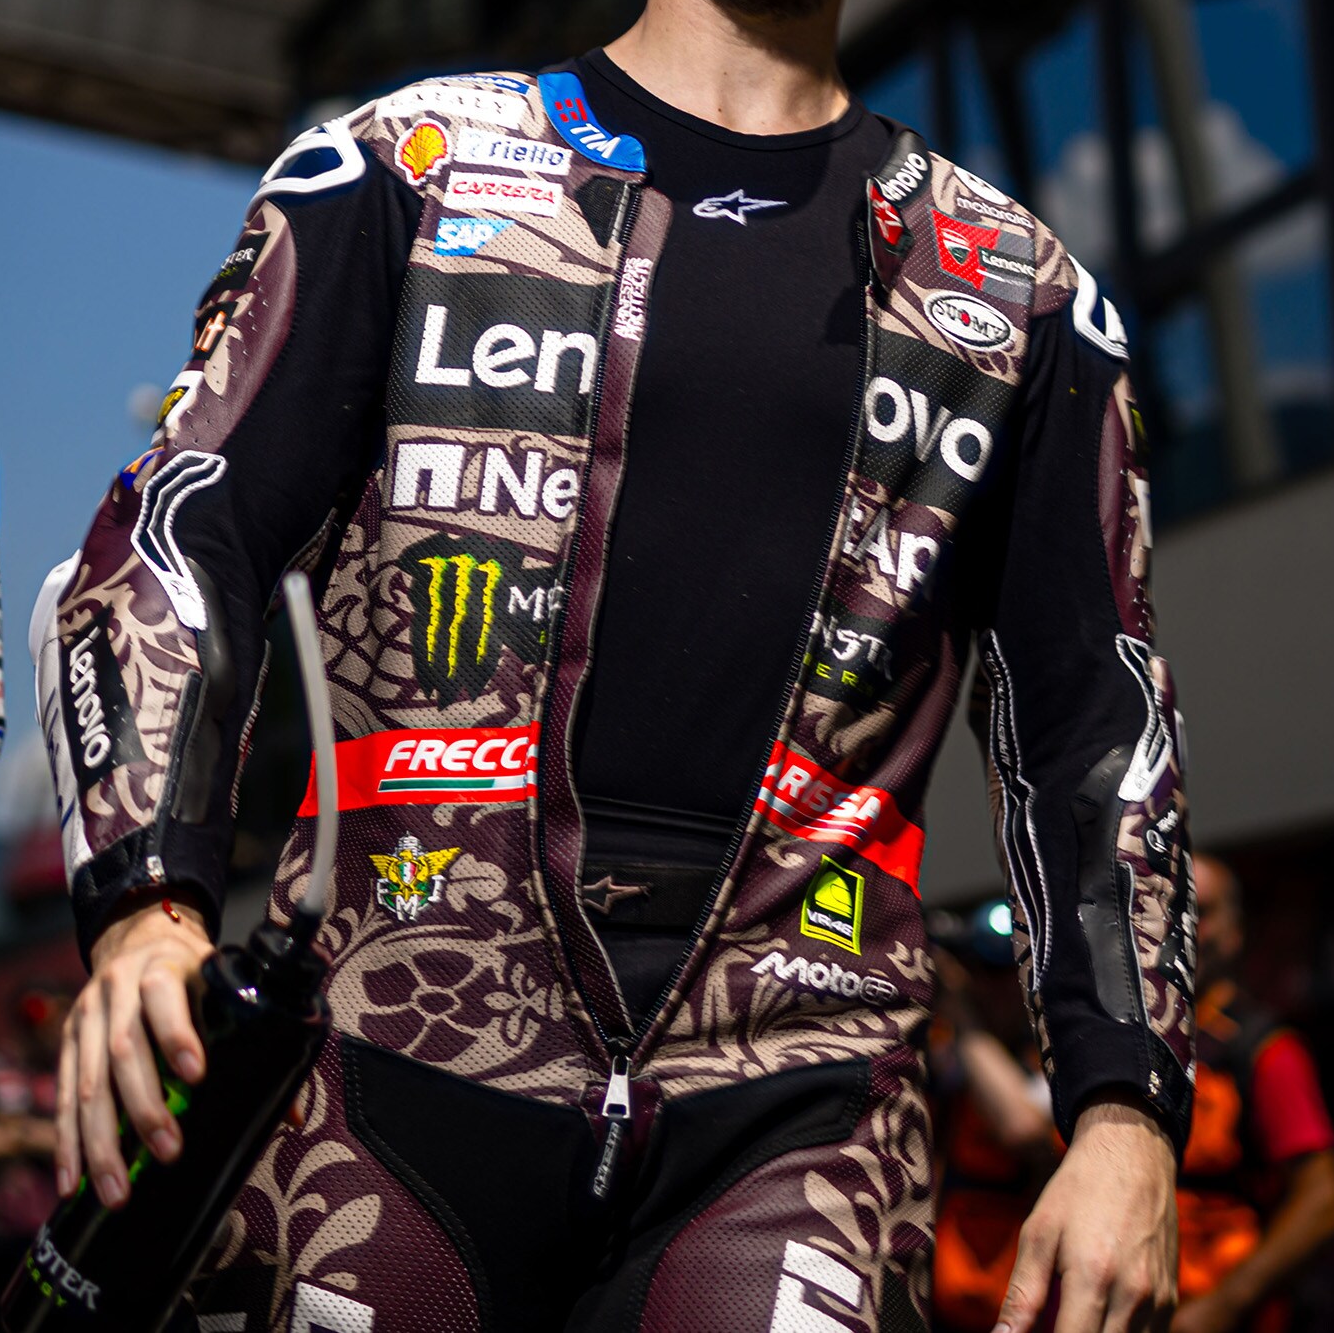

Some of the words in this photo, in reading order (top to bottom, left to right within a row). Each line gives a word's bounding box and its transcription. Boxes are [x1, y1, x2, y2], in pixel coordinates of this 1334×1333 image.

[489, 140, 565, 166] riello
[571, 123, 621, 159] TIM
[452, 181, 555, 204] CARRERA
[956, 197, 1035, 229] motorola
[436, 223, 495, 251] SAP
[935, 299, 1009, 340] SUOMY
[414, 304, 597, 395] Len
[69, 626, 113, 769] Lenovo
[806, 907, 855, 938] VR46
